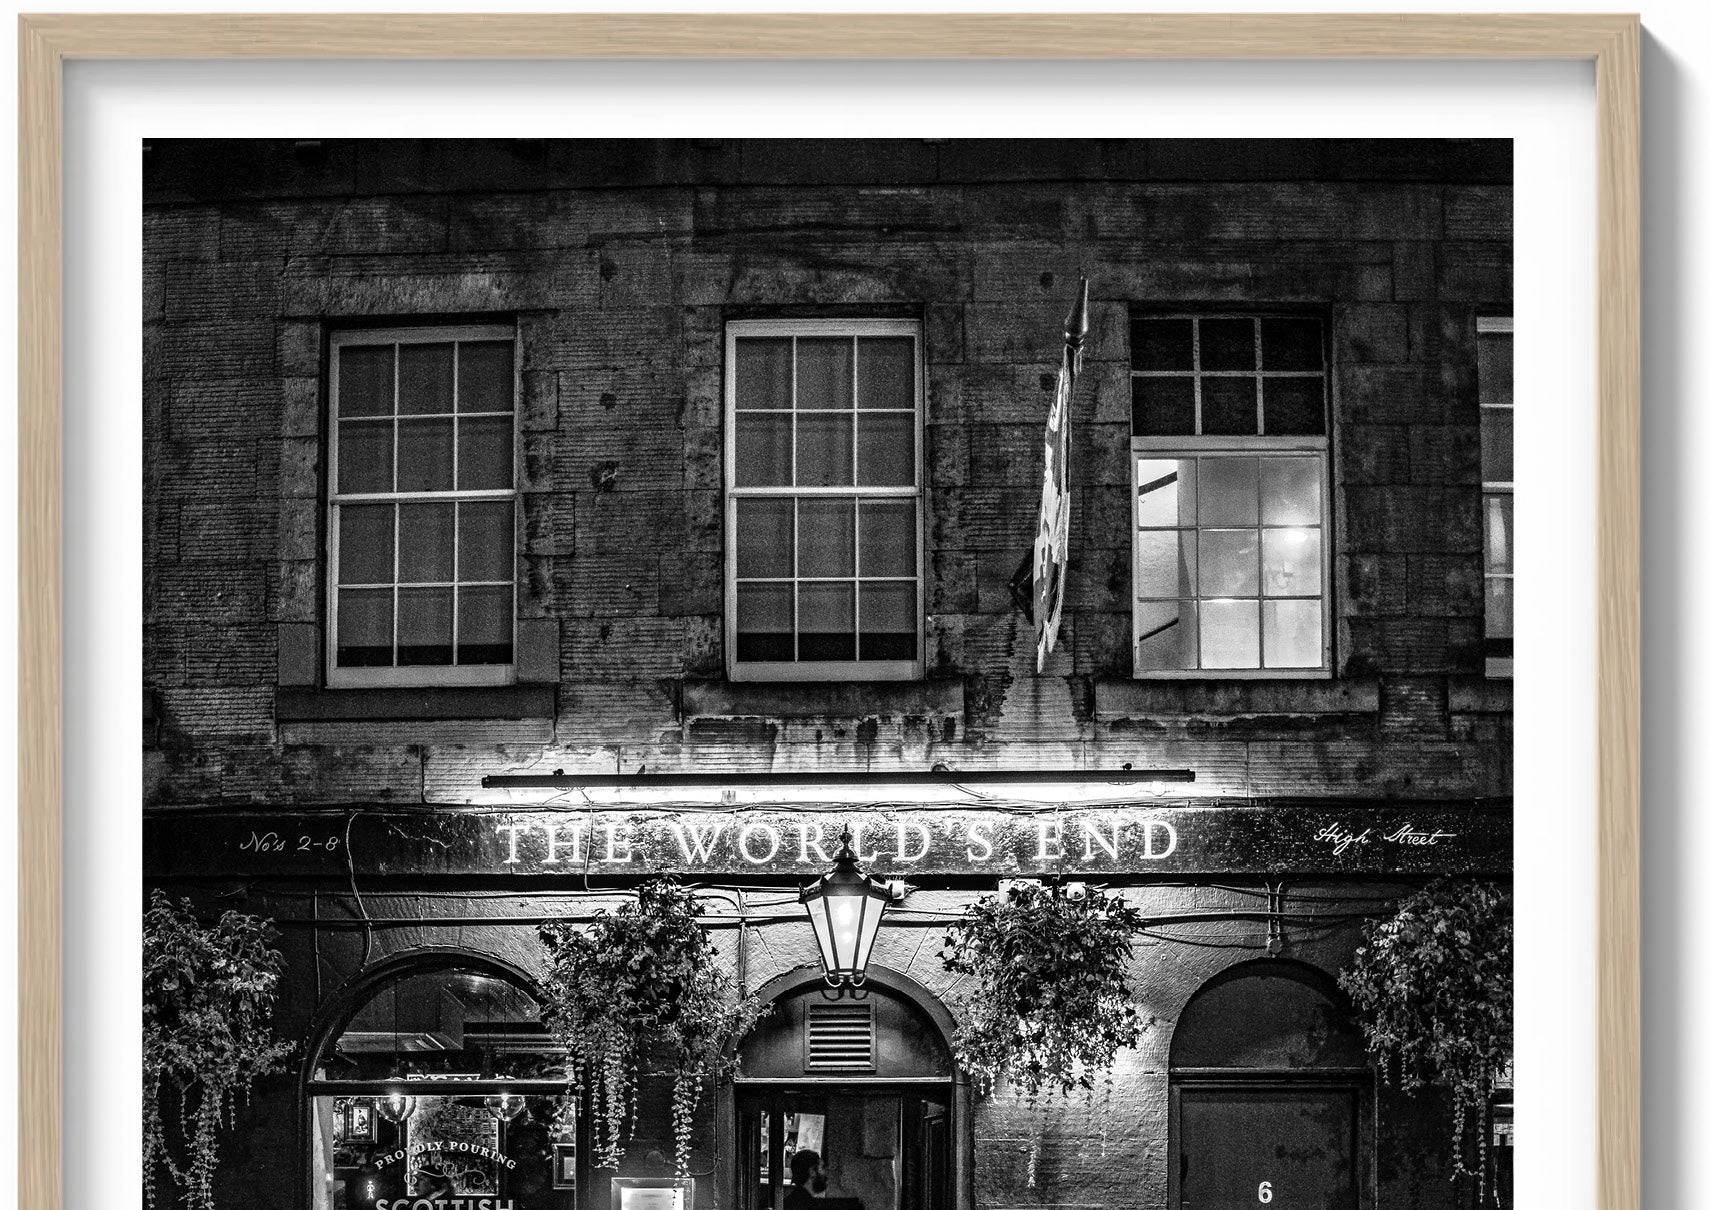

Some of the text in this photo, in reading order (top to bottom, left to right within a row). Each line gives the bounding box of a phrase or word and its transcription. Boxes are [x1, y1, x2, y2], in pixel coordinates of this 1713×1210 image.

[296, 835, 339, 851] 2-8
[495, 820, 1178, 865] THE WORLD'S END
[1313, 821, 1457, 856] High Street
[450, 1141, 517, 1170] POURING
[1258, 1181, 1273, 1204] 6
